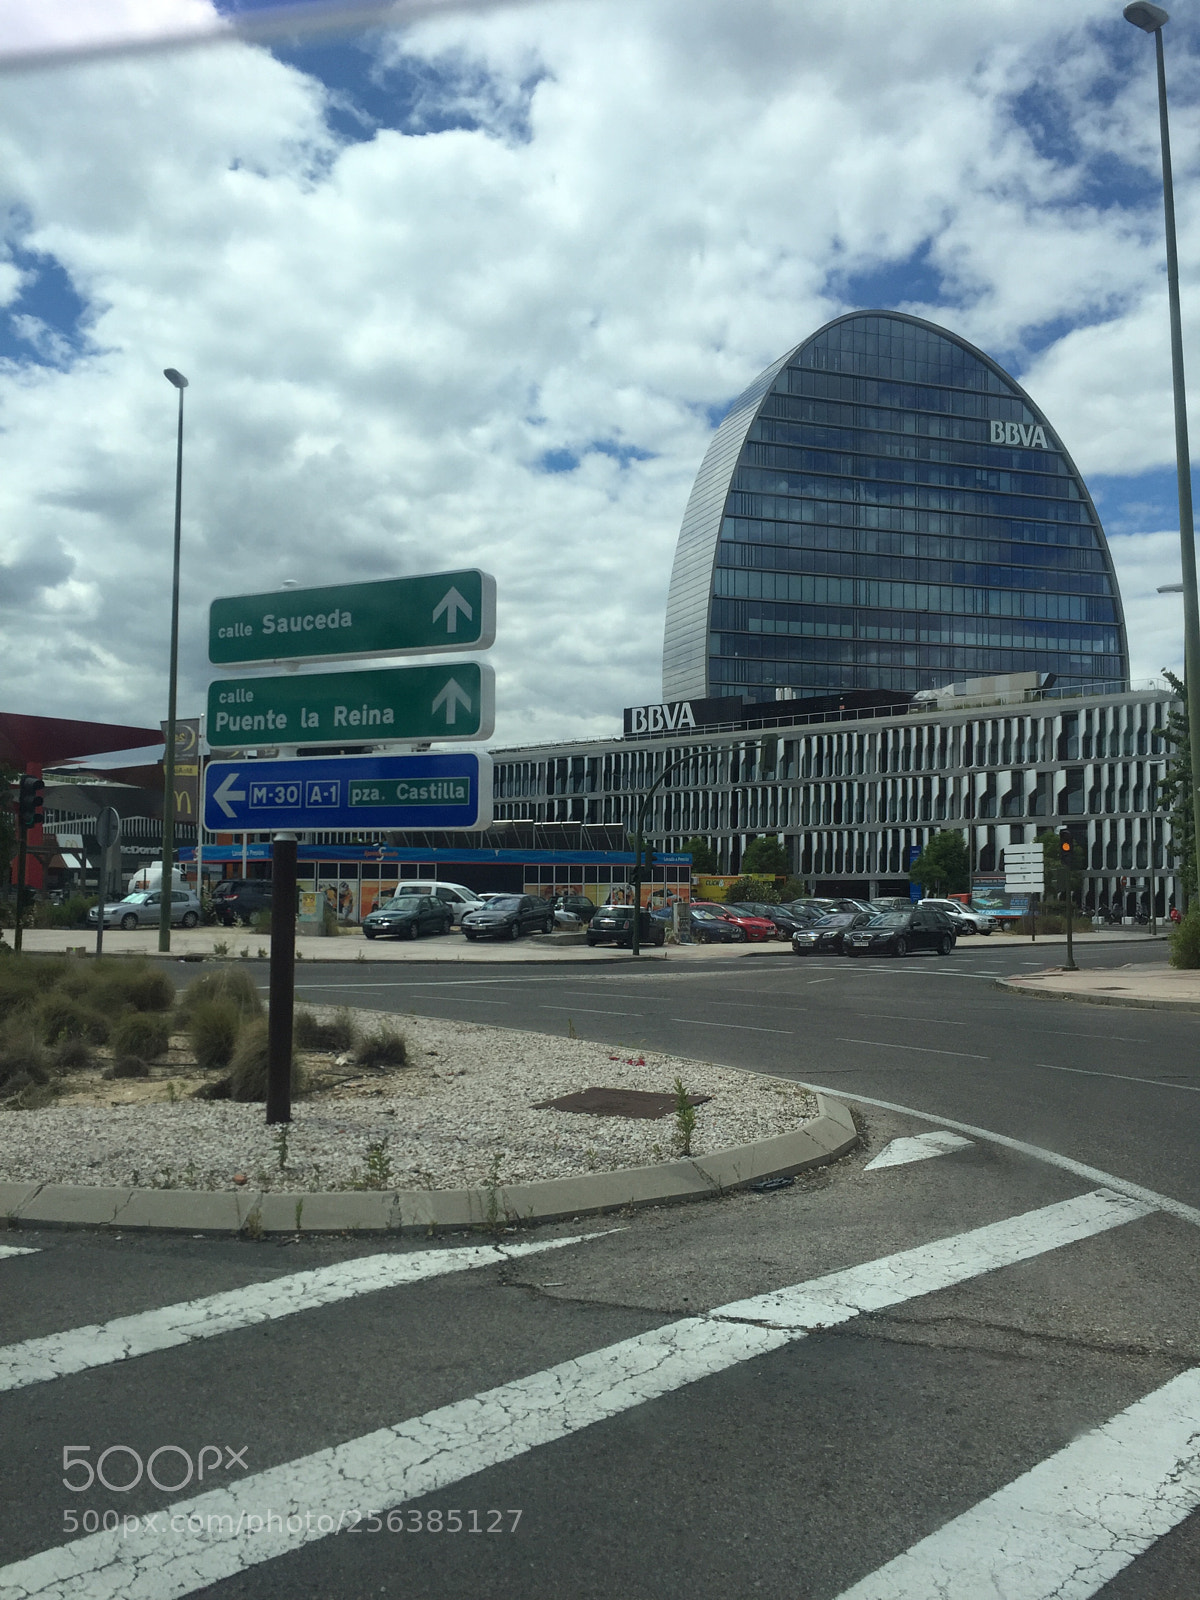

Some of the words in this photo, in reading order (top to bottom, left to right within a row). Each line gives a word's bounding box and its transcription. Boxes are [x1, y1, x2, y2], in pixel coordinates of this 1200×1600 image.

[991, 420, 1048, 448] BBVA
[218, 623, 252, 638] calle
[262, 609, 352, 634] Sauceda
[219, 688, 254, 704] calle
[216, 709, 287, 732] Puente
[301, 707, 319, 728] la
[334, 704, 394, 727] Reina
[632, 702, 696, 733] BBVA
[252, 785, 298, 804] M-30
[310, 785, 337, 803] A-1
[352, 787, 385, 805] pza.
[396, 782, 465, 801] Castilla
